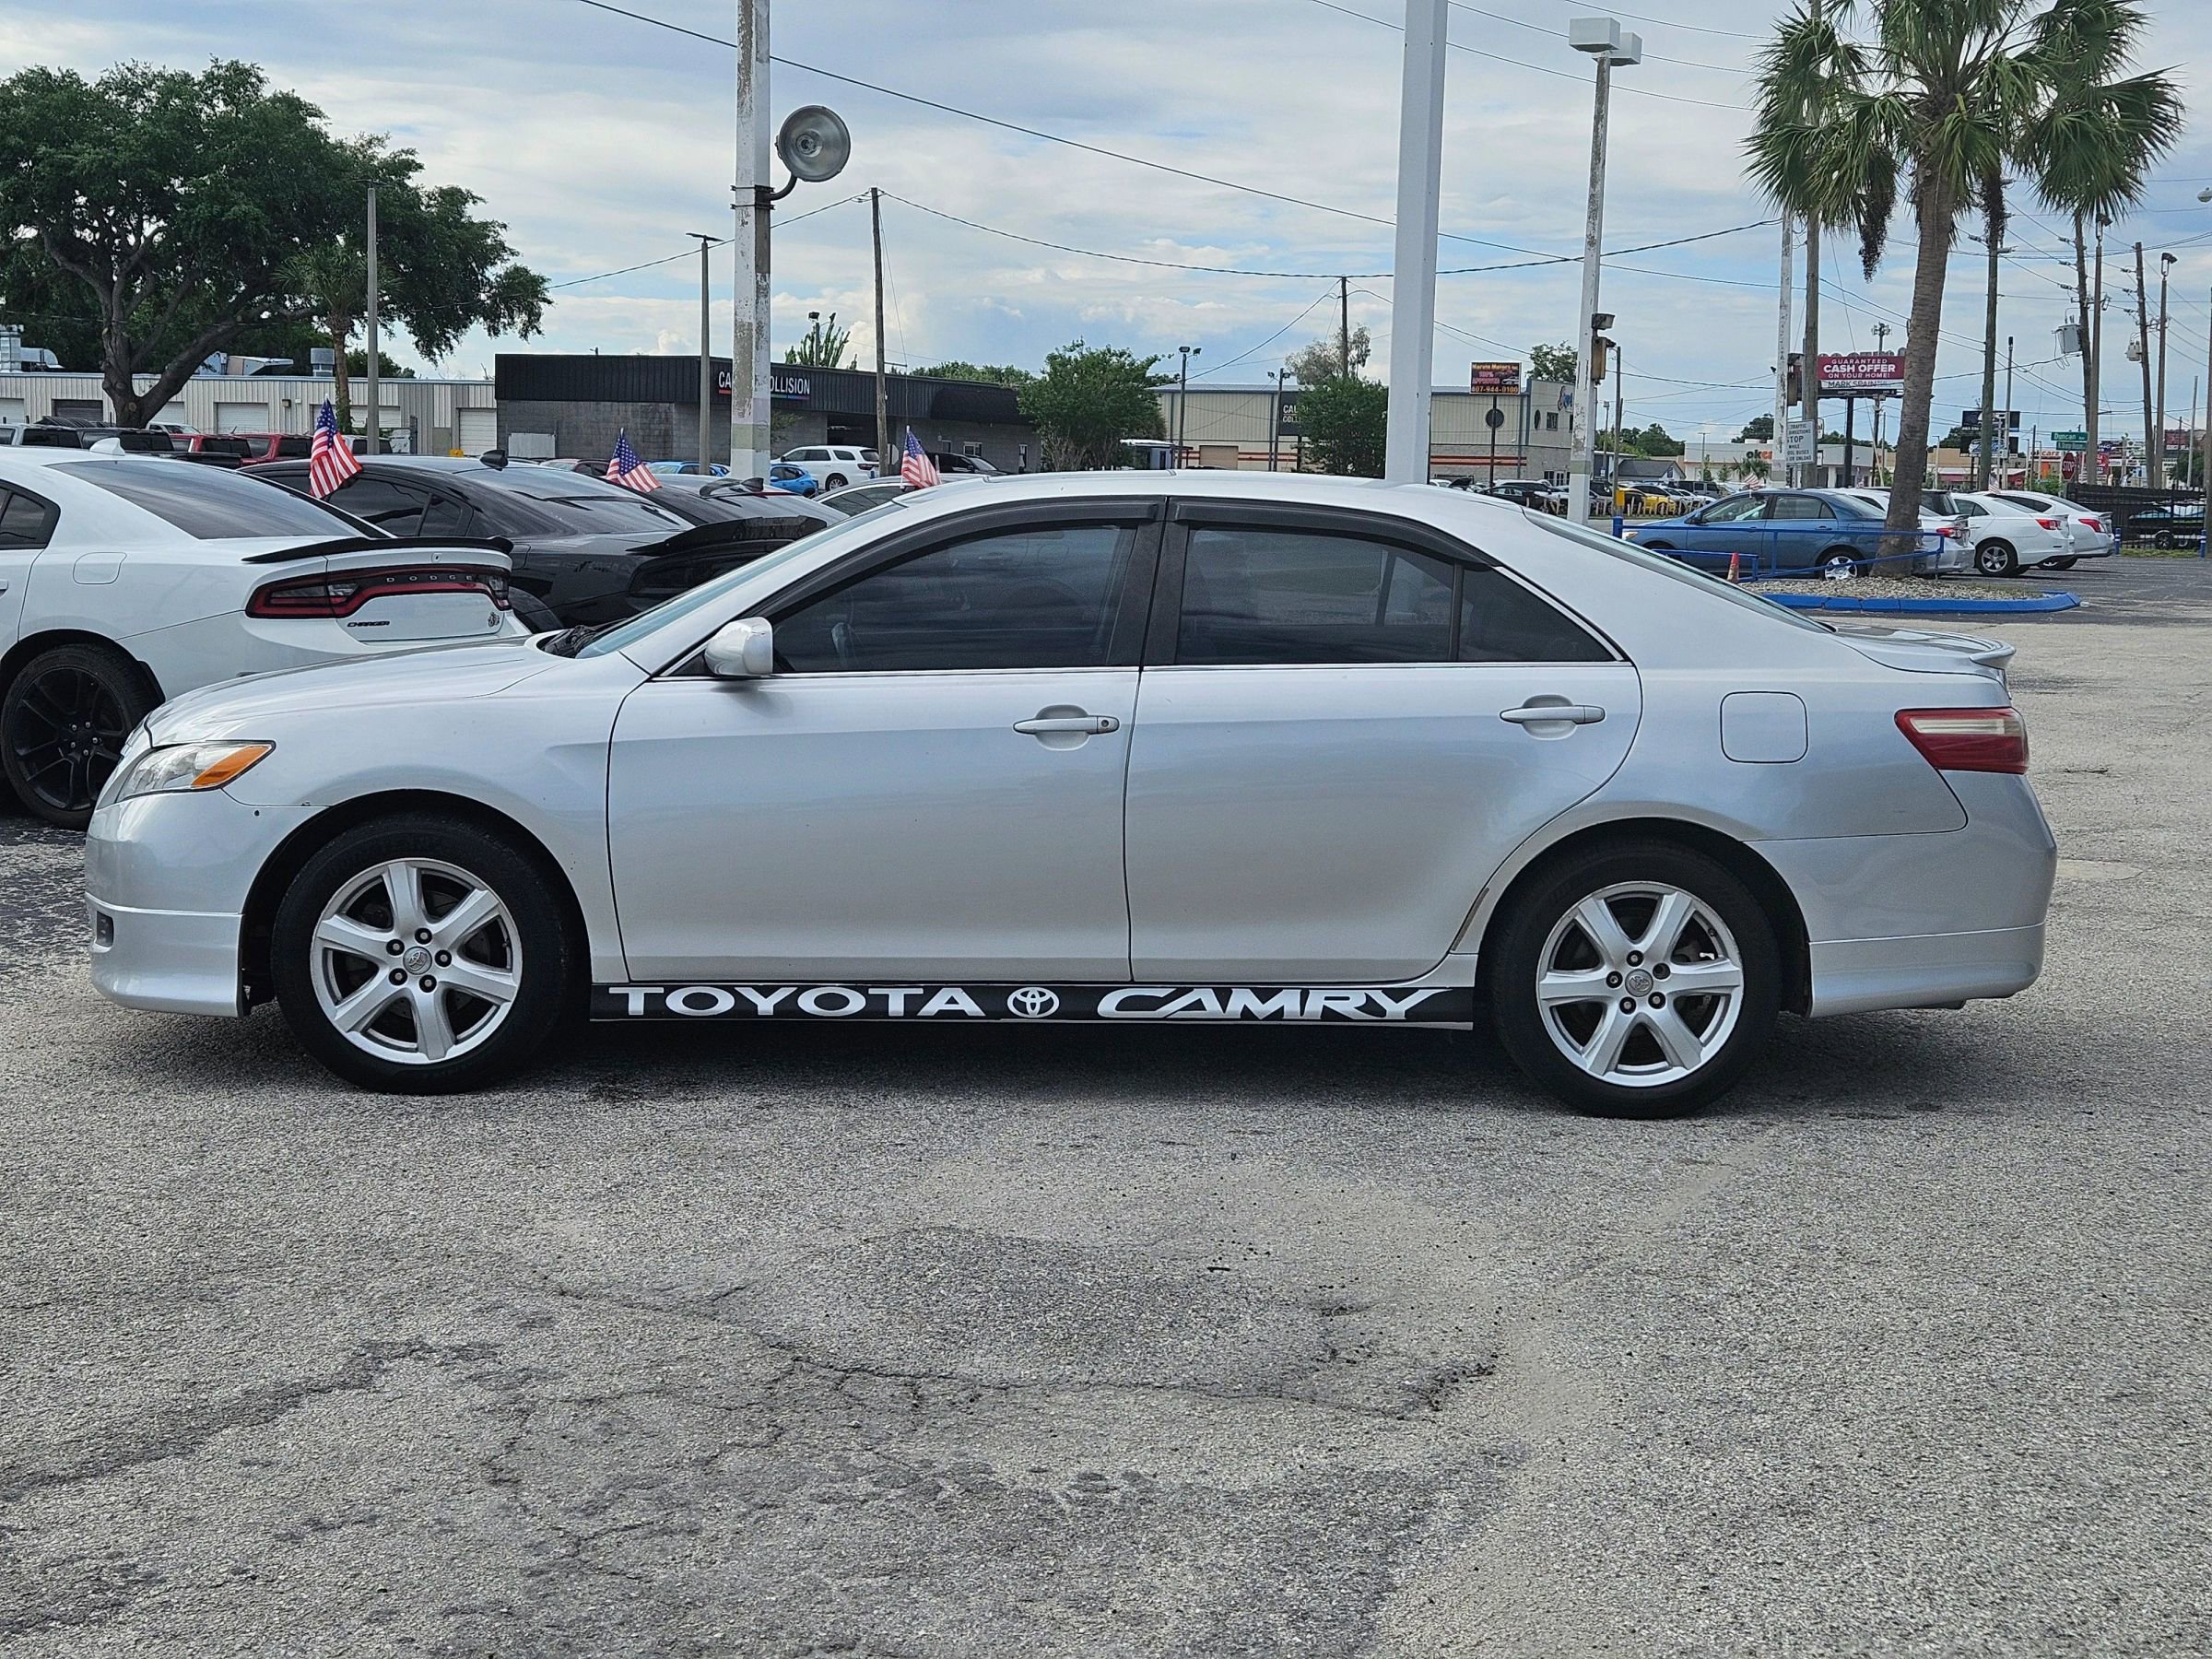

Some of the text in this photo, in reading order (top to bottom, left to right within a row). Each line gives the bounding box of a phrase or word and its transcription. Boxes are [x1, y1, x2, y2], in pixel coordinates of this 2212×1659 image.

[1824, 364, 1896, 372] CASH OFFER
[770, 375, 810, 394] OLLISION
[2063, 461, 2075, 472] STOP
[386, 574, 473, 582] DODGE
[608, 986, 1453, 1019] TOYOTA CAMRY
